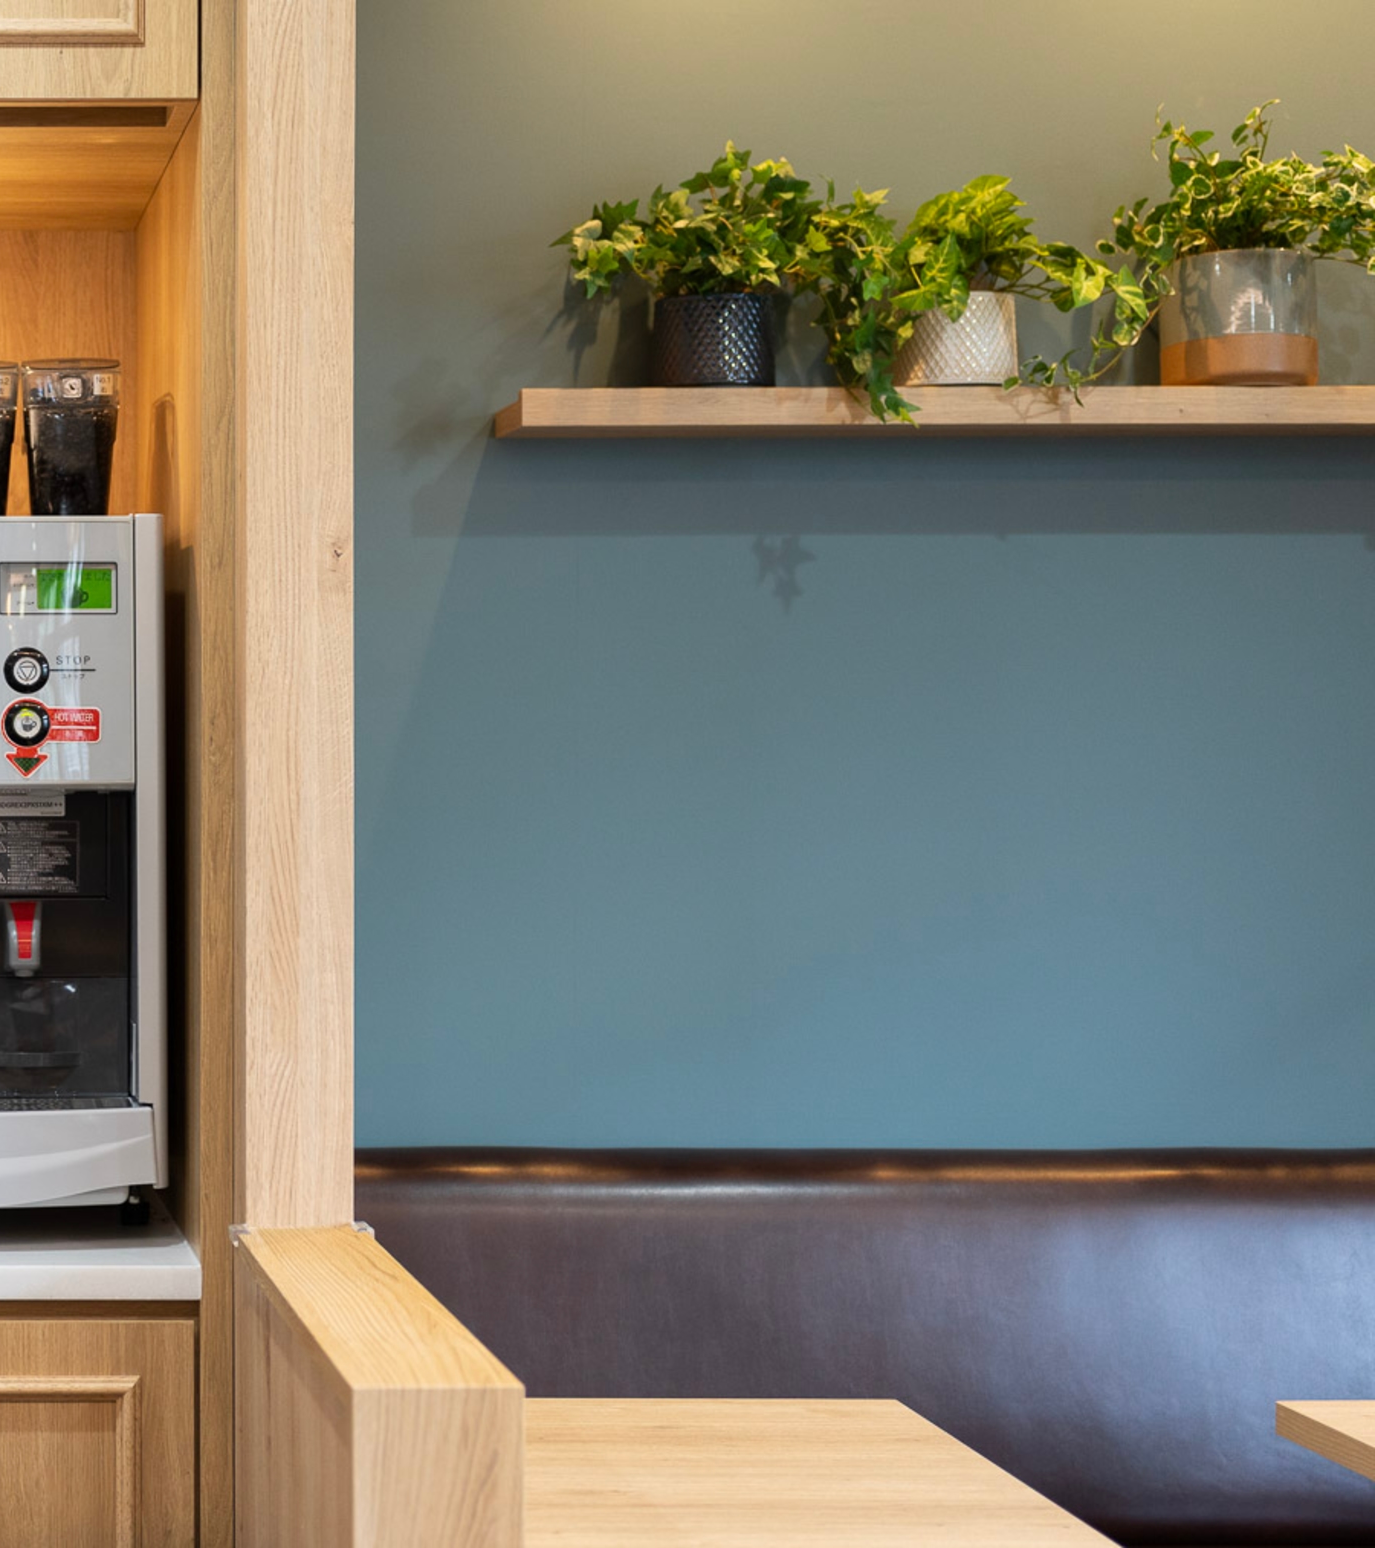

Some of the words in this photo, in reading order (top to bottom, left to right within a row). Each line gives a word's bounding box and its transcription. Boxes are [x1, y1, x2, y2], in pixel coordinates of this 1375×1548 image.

[55, 655, 91, 665] STOP
[54, 712, 67, 722] HOT
[70, 713, 94, 722] WATER
